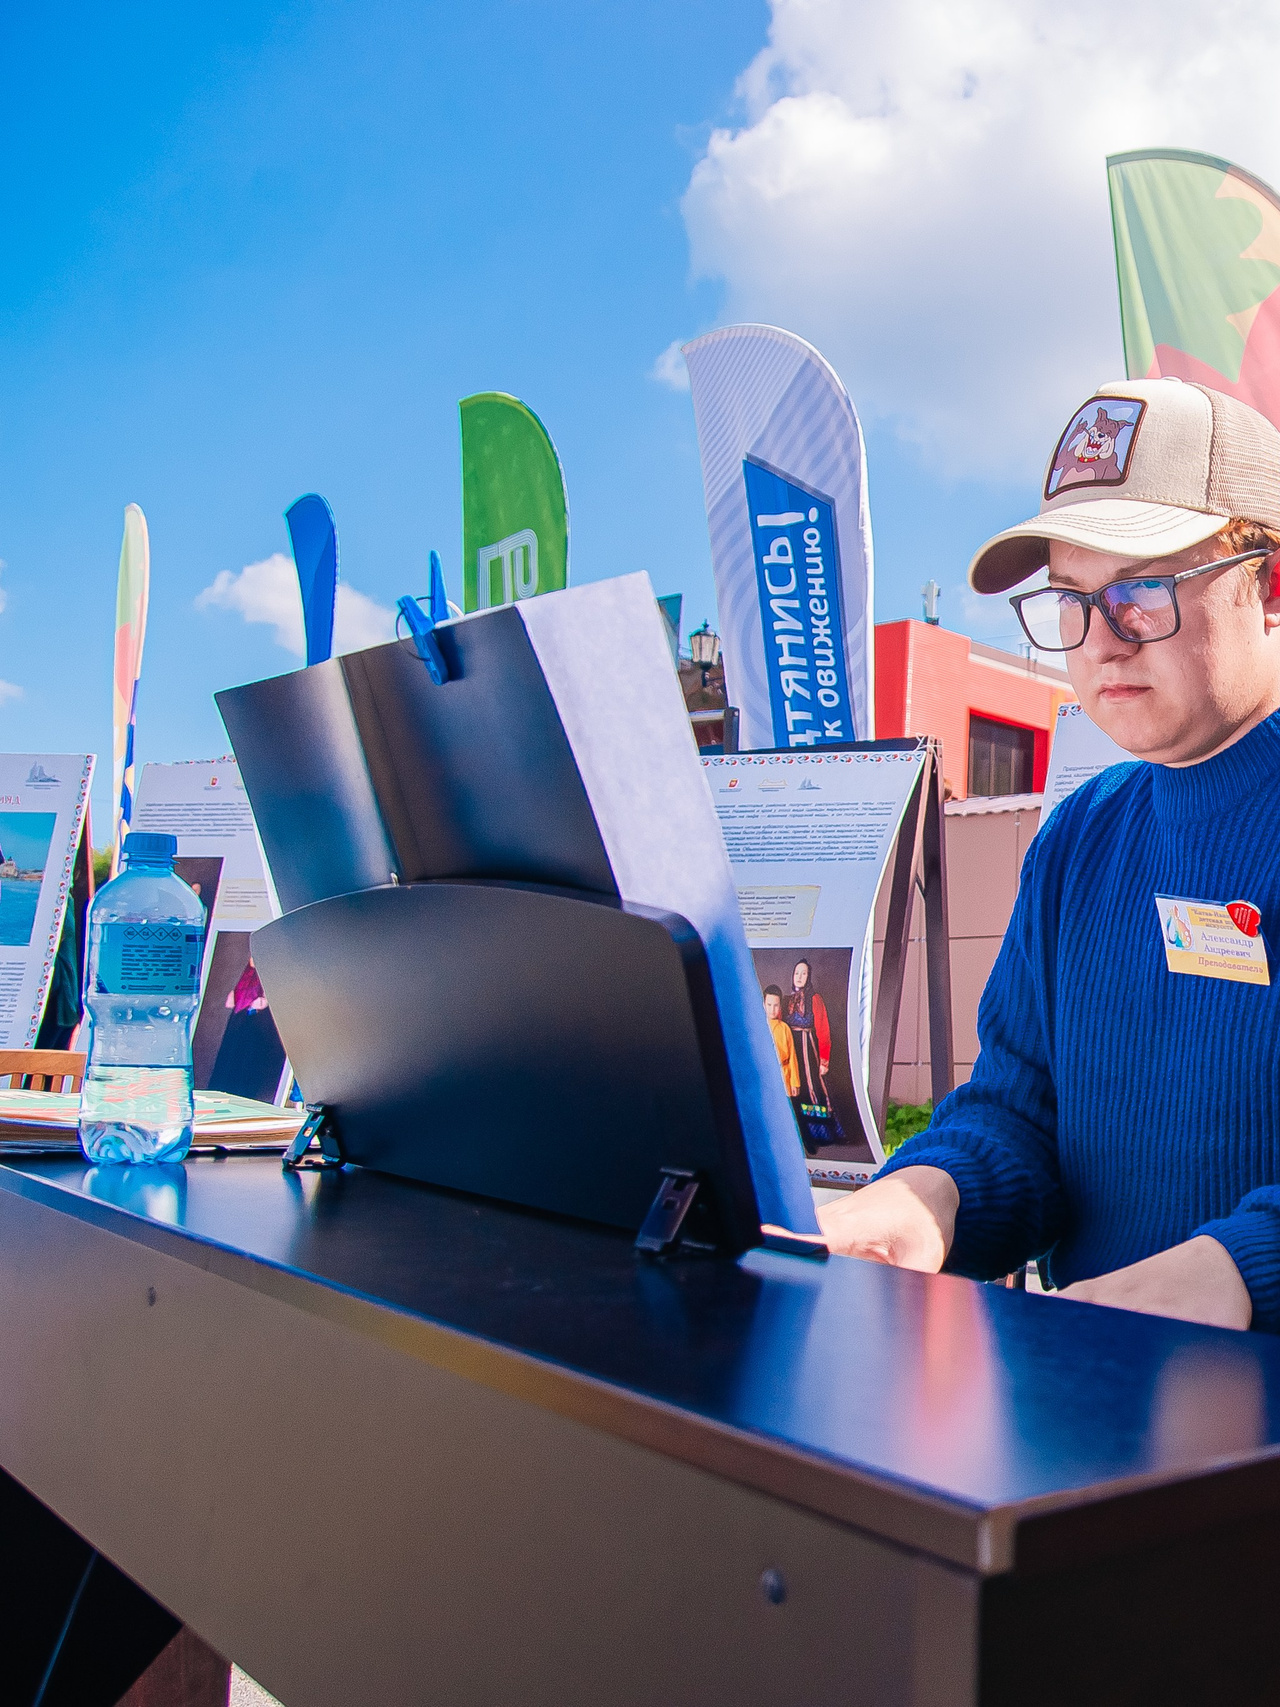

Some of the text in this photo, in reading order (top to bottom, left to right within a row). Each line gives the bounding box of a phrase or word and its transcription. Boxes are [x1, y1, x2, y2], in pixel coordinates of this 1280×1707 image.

[1201, 932, 1254, 949] Александр
[1204, 944, 1251, 957] Андреевич
[1198, 957, 1263, 973] Преподаватель
